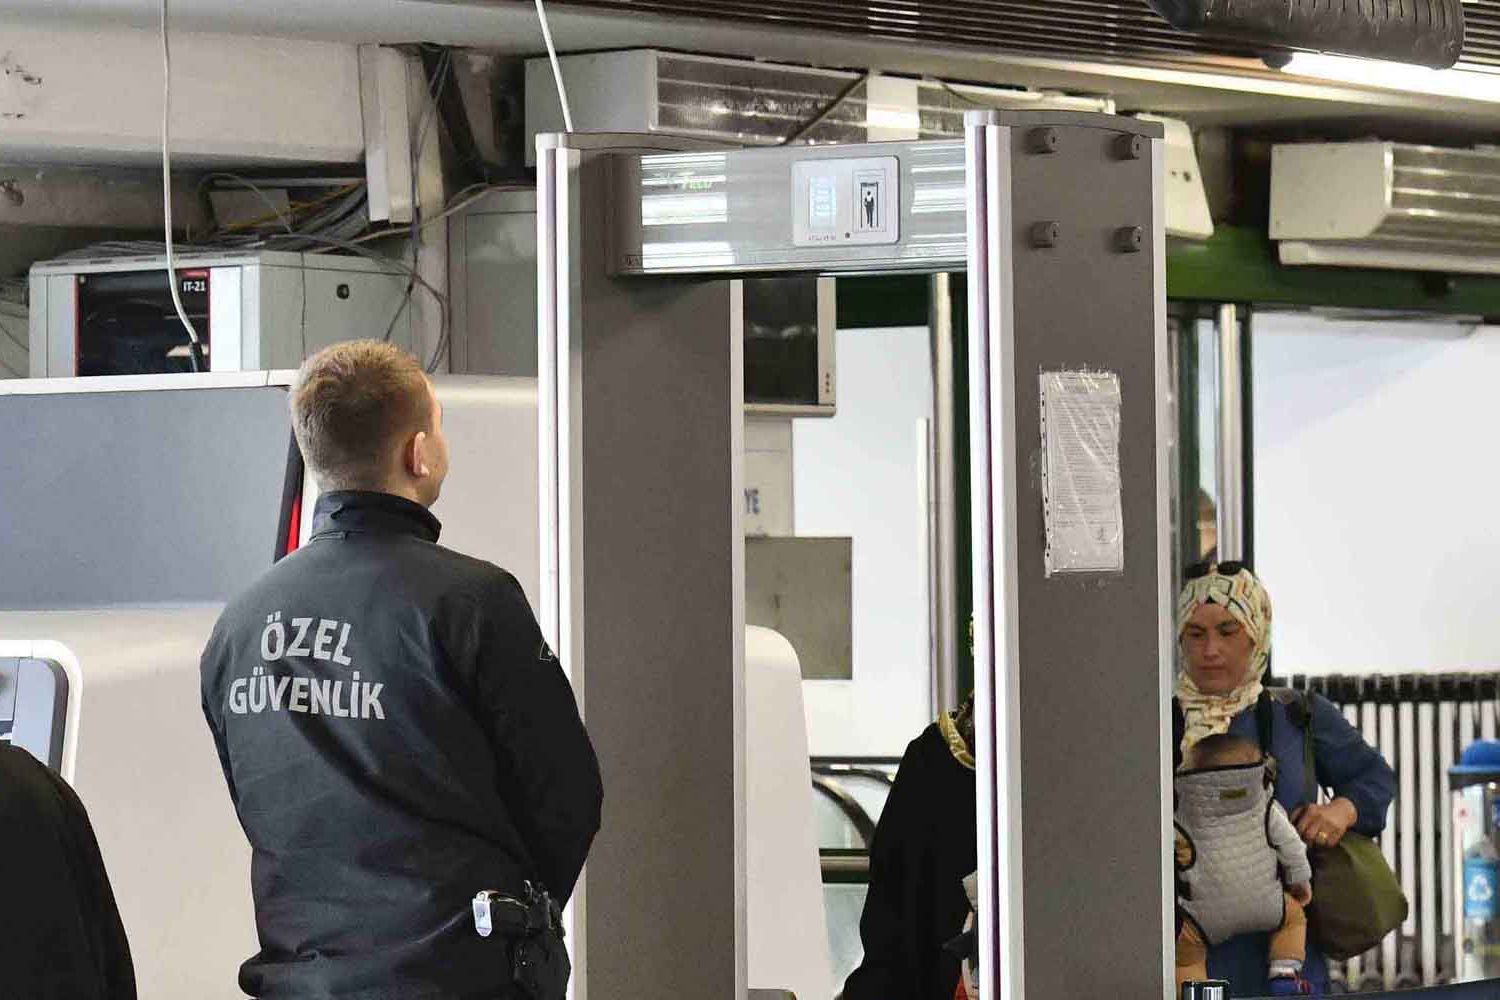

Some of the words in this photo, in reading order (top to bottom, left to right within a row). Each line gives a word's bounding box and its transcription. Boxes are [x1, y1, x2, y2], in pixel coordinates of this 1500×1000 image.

[183, 280, 206, 292] IT-21
[260, 610, 352, 666] ÖZEL
[228, 666, 386, 720] GÜVENLİK
